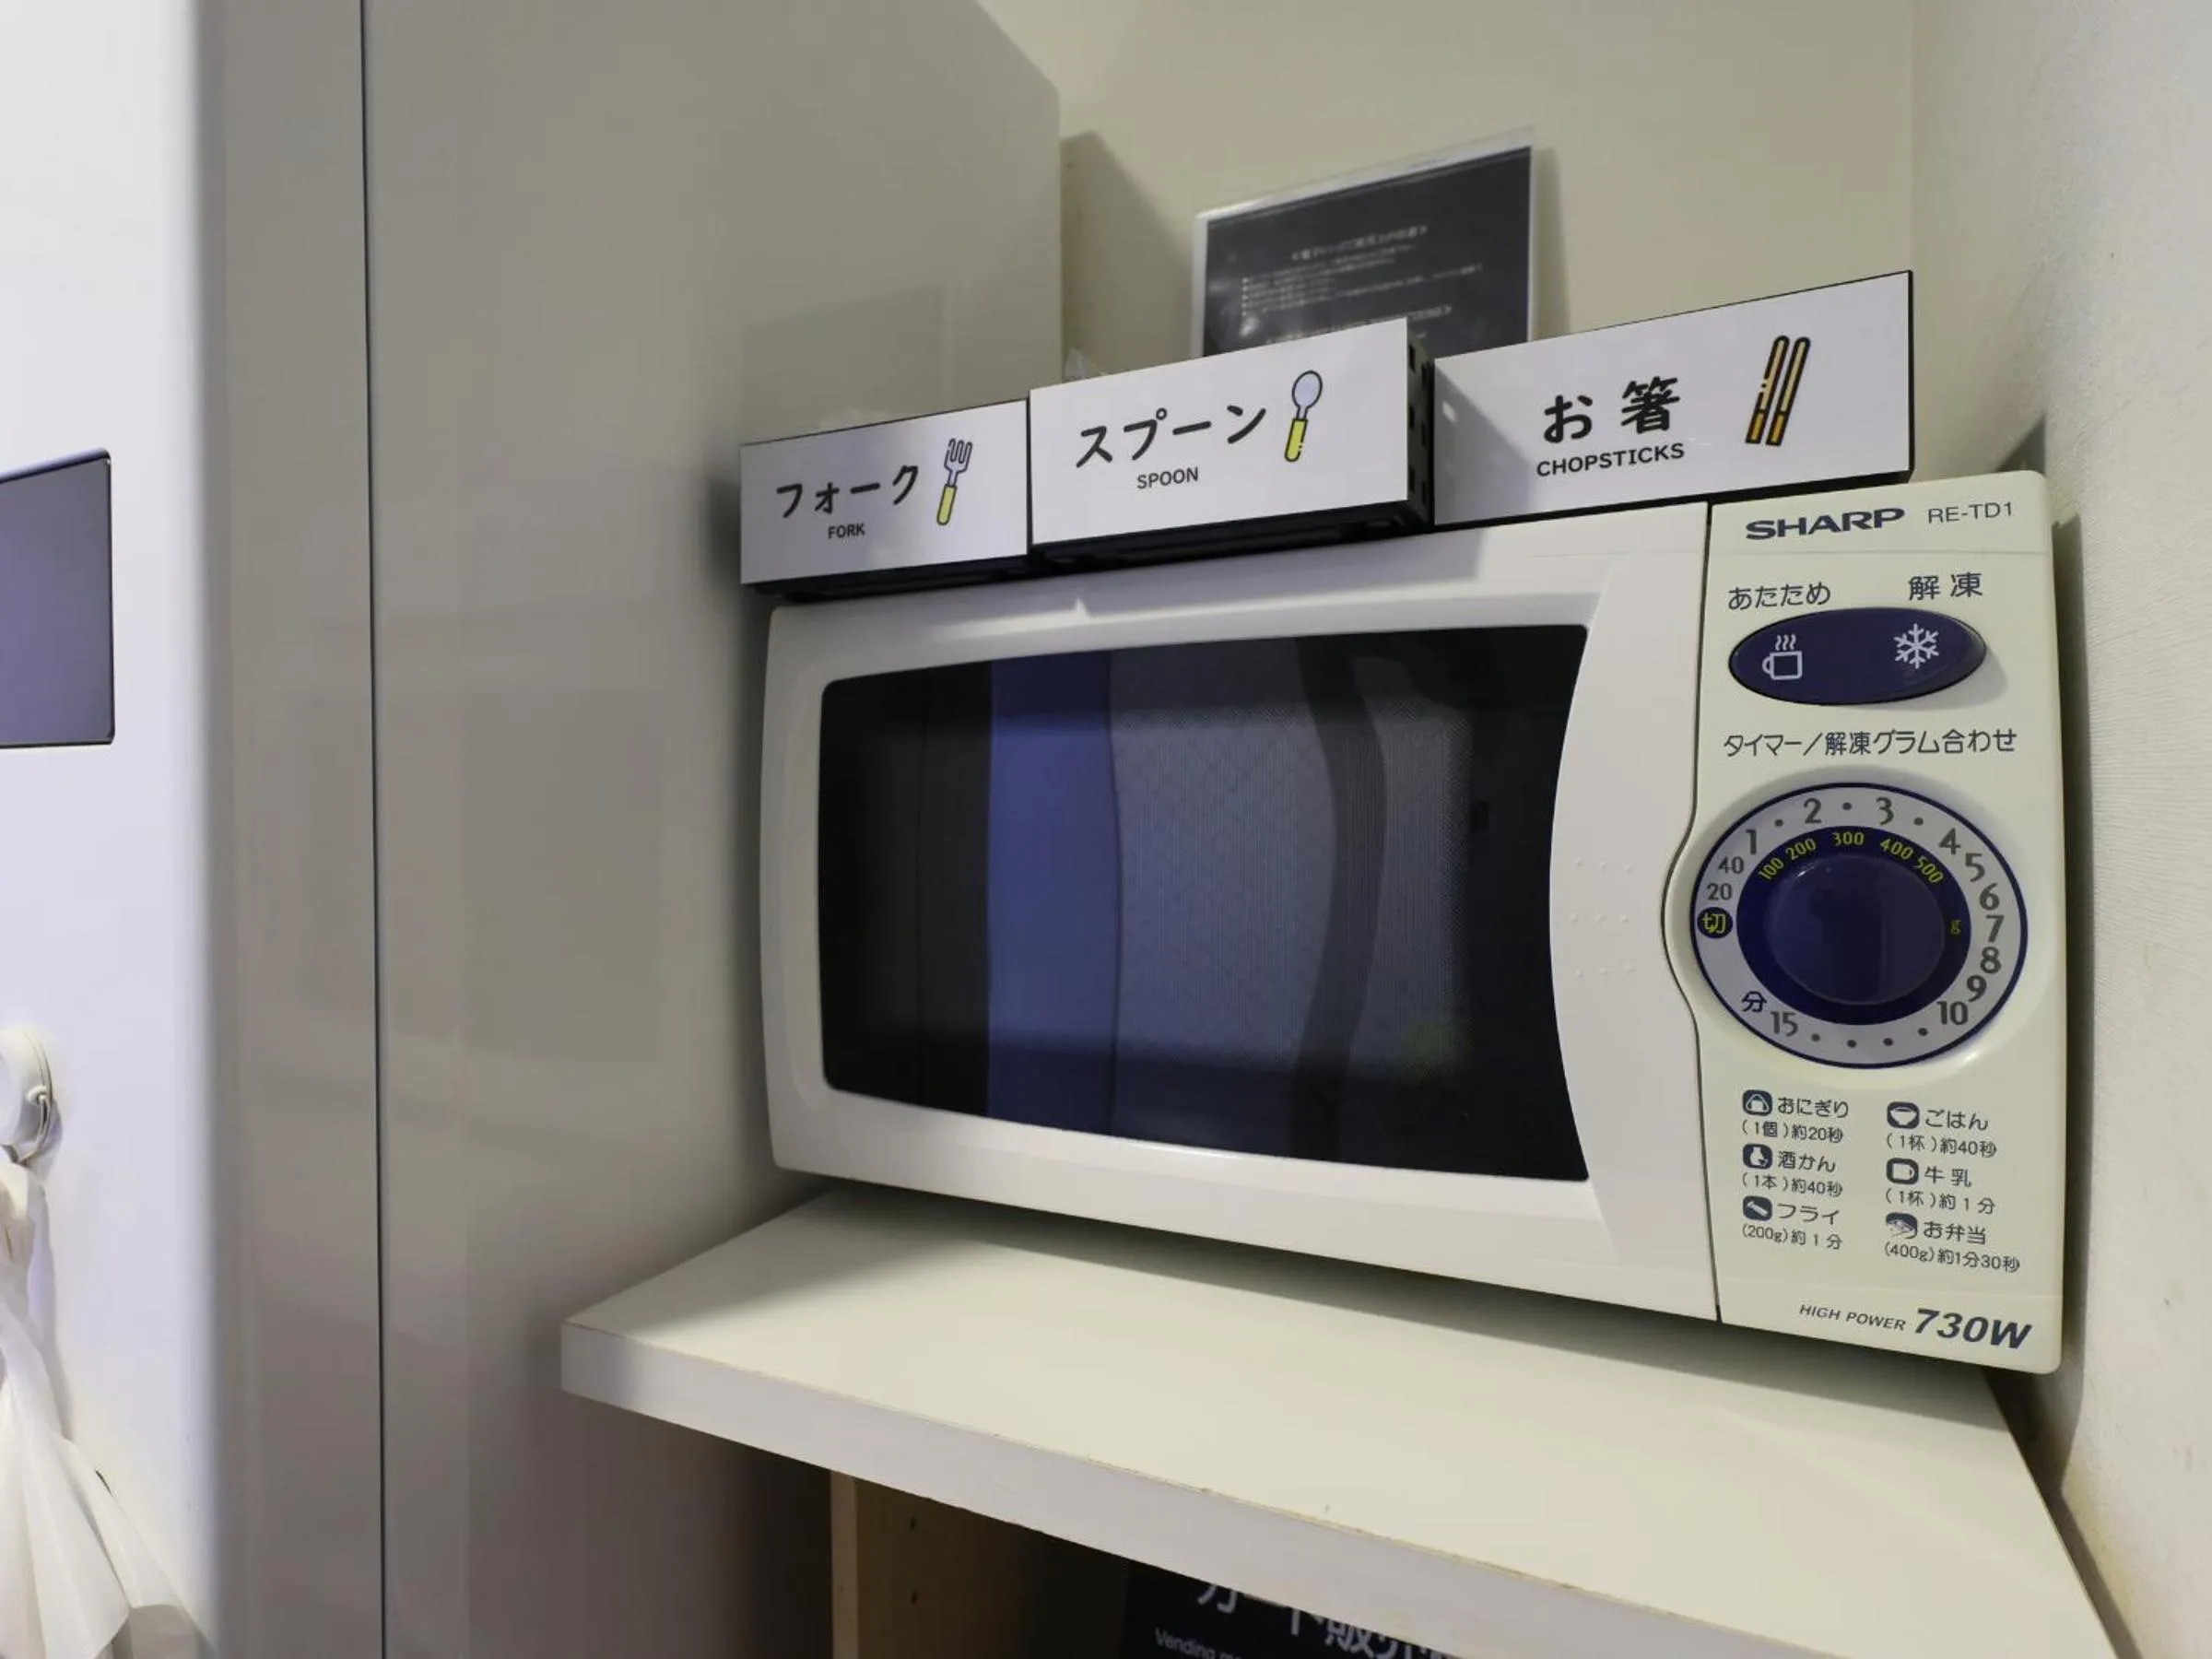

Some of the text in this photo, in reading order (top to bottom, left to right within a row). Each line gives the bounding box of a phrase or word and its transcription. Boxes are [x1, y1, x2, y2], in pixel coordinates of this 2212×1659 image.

[1543, 376, 1681, 444] お箸
[1076, 404, 1267, 467] スプーン
[1536, 442, 1685, 477] CHOPSTICKS
[775, 464, 919, 518] フォーク
[1136, 466, 1199, 489] SPOON
[828, 523, 865, 539] FORK
[1746, 501, 2012, 540] SHARP RE-TD1
[1727, 582, 1830, 610] あたため
[1908, 572, 1983, 600] 解凍
[1759, 857, 1783, 881] 100
[1785, 837, 1817, 862] 200
[1832, 831, 1865, 845] 300
[1879, 837, 1914, 860] 400
[1915, 855, 1944, 884] 500
[1707, 796, 2005, 1037] 20 40 1 2 3 4 5 6 7 8 9 10 15
[1741, 991, 1767, 1013] 分
[1777, 1096, 1849, 1118] おにぎり
[1924, 1109, 1988, 1131] ごはん
[1777, 1151, 1835, 1172] 酒かん
[1924, 1166, 1971, 1187] 牛乳
[1777, 1203, 1840, 1225] フライ
[1924, 1220, 1986, 1245] お弁当
[1799, 1304, 2032, 1349] HIGH POWER 730W
[1155, 1627, 1216, 1659] Vending
